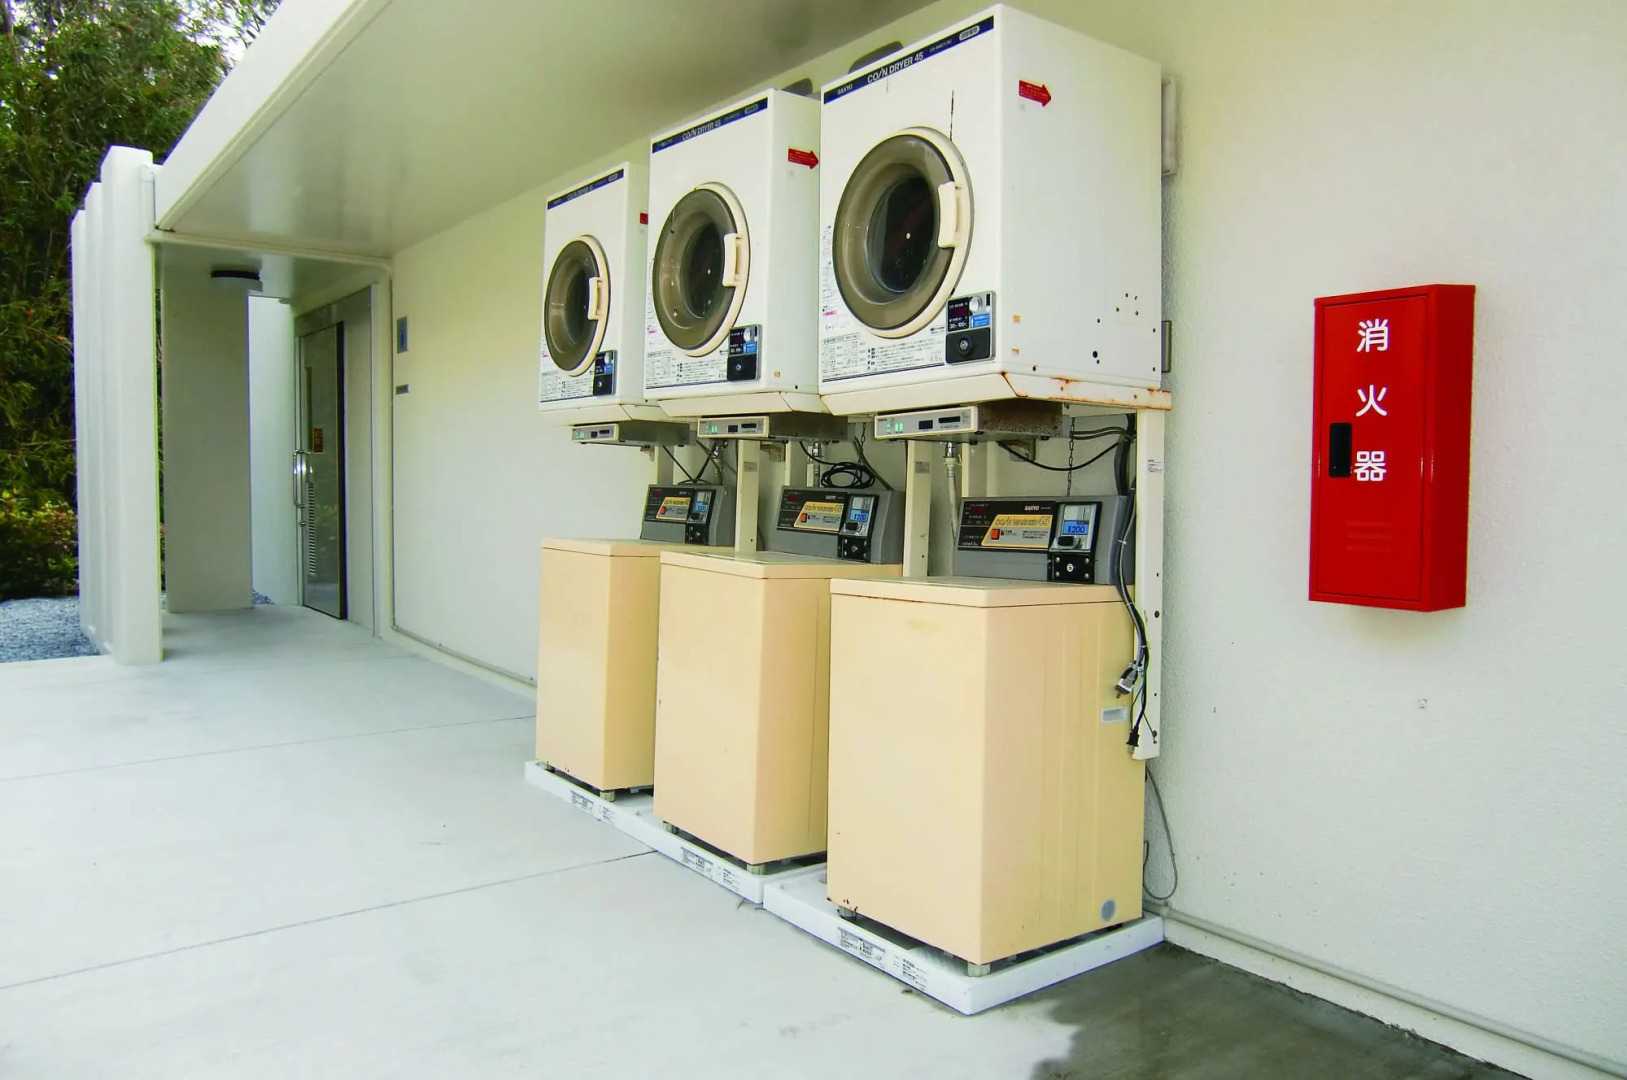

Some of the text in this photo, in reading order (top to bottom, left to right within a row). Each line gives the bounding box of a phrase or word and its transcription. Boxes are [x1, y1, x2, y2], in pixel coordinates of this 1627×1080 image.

[889, 56, 914, 74] DRYER
[914, 51, 924, 62] 45
[1354, 318, 1390, 483] 消火器
[1067, 525, 1086, 534] ¥200
